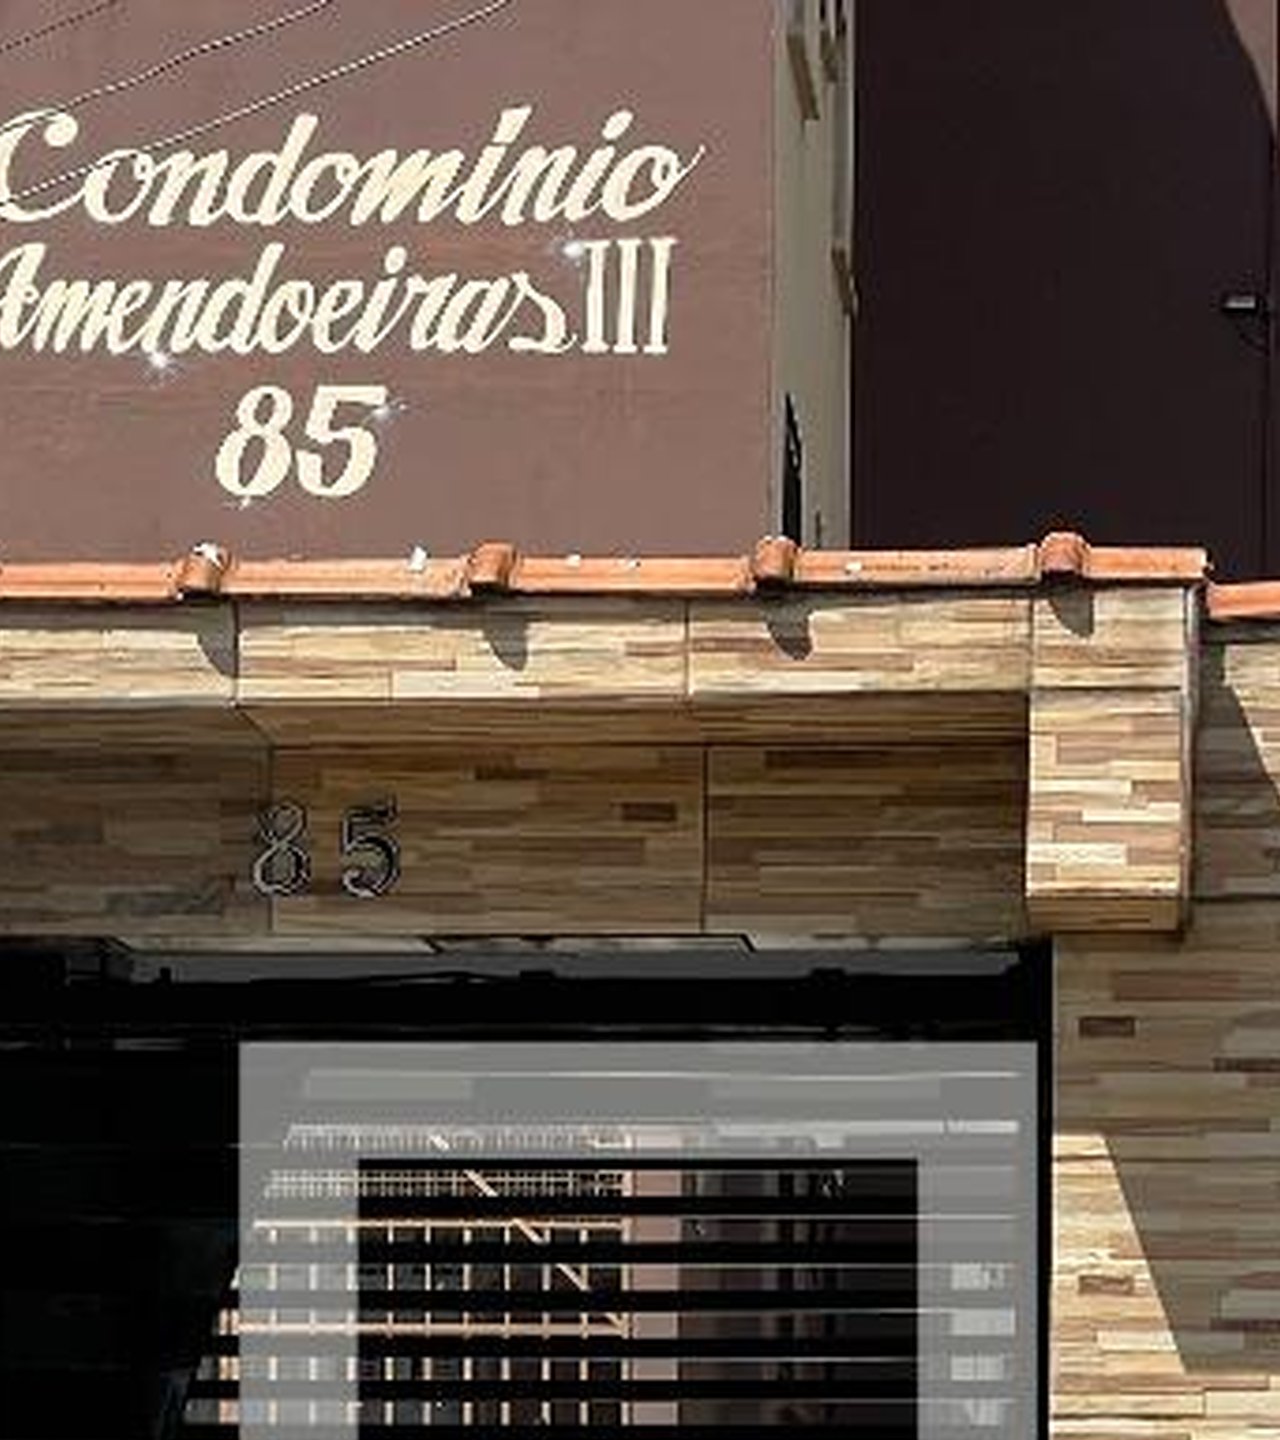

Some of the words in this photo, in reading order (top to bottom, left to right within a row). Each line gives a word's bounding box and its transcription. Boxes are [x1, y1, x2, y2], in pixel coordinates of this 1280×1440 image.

[581, 238, 677, 354] III
[214, 384, 389, 498] 85
[252, 796, 402, 898] 85
